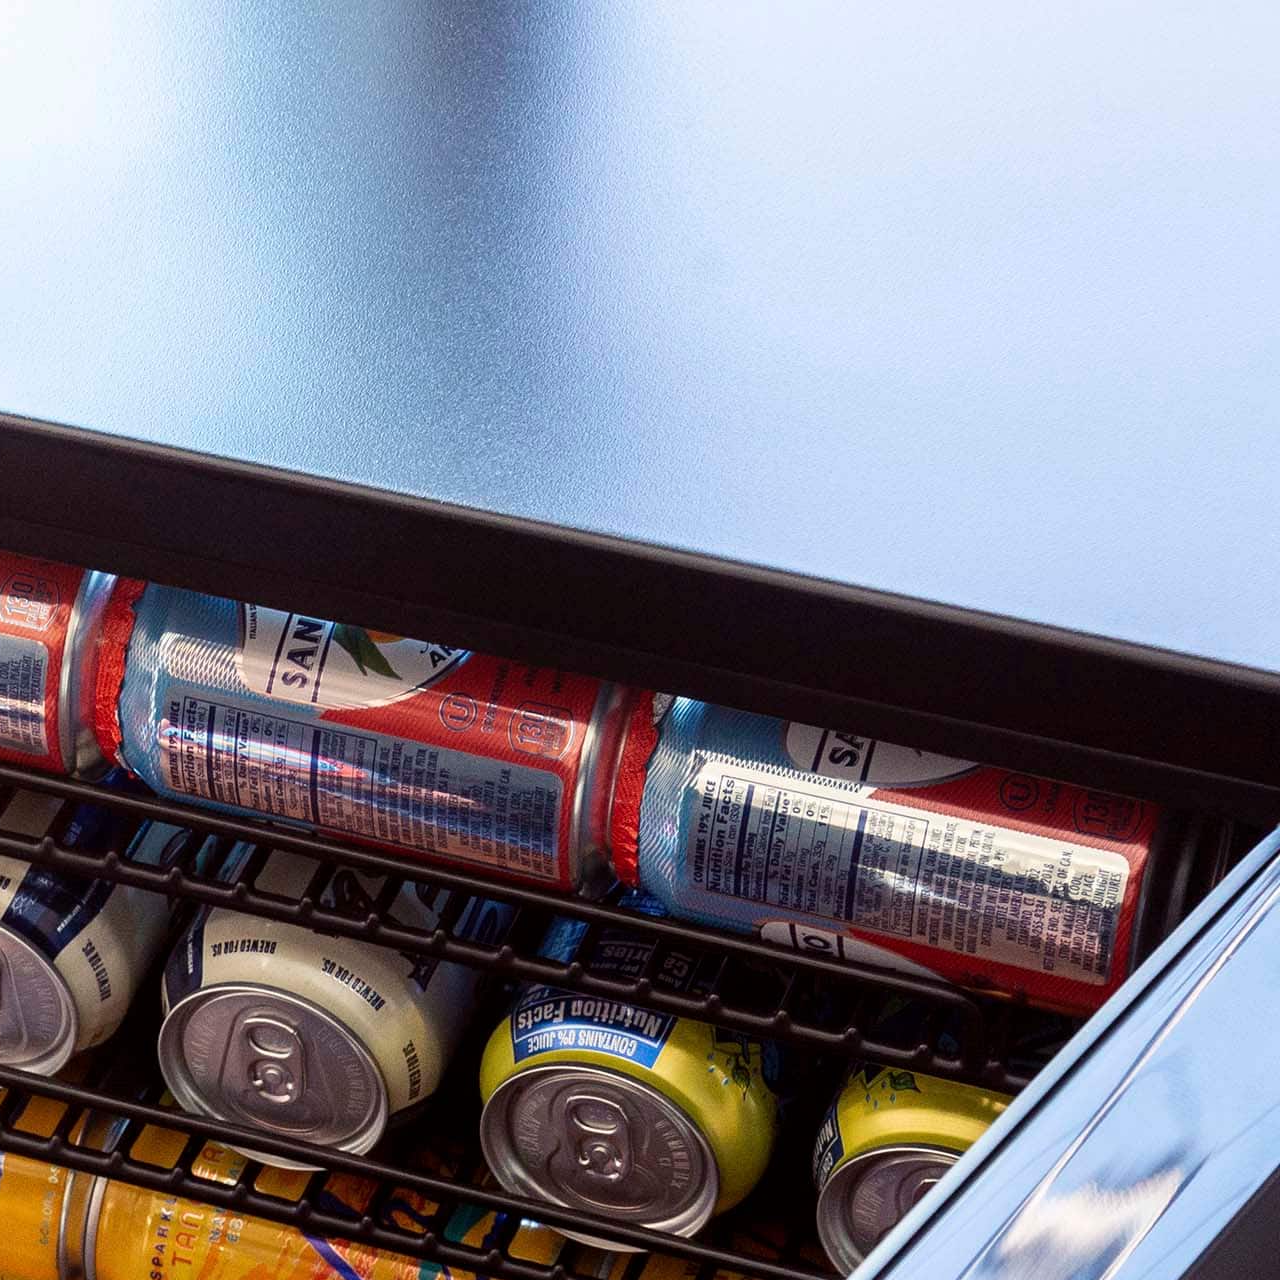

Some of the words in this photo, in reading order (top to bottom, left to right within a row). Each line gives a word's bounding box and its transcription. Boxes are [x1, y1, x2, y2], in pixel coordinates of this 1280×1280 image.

[182, 699, 198, 742] Facts
[828, 734, 865, 768] SA
[700, 778, 716, 811] JUICE
[715, 776, 735, 826] Facts
[697, 810, 710, 835] 19%
[691, 837, 706, 884] CONTAINS
[707, 827, 726, 891] Nutrition
[770, 835, 784, 867] Daily
[1092, 867, 1109, 908] SUNLIGHT
[222, 940, 239, 955] FOR
[238, 941, 277, 955] BREWED
[334, 963, 355, 985] FOR
[350, 975, 387, 1011] BREWED
[518, 1002, 566, 1029] Facts
[571, 1000, 662, 1038] Nutrition
[528, 1031, 556, 1053] JUICE
[558, 1030, 577, 1046] 0%
[578, 1028, 637, 1056] CONTAINS
[150, 1196, 177, 1280] SPARKL
